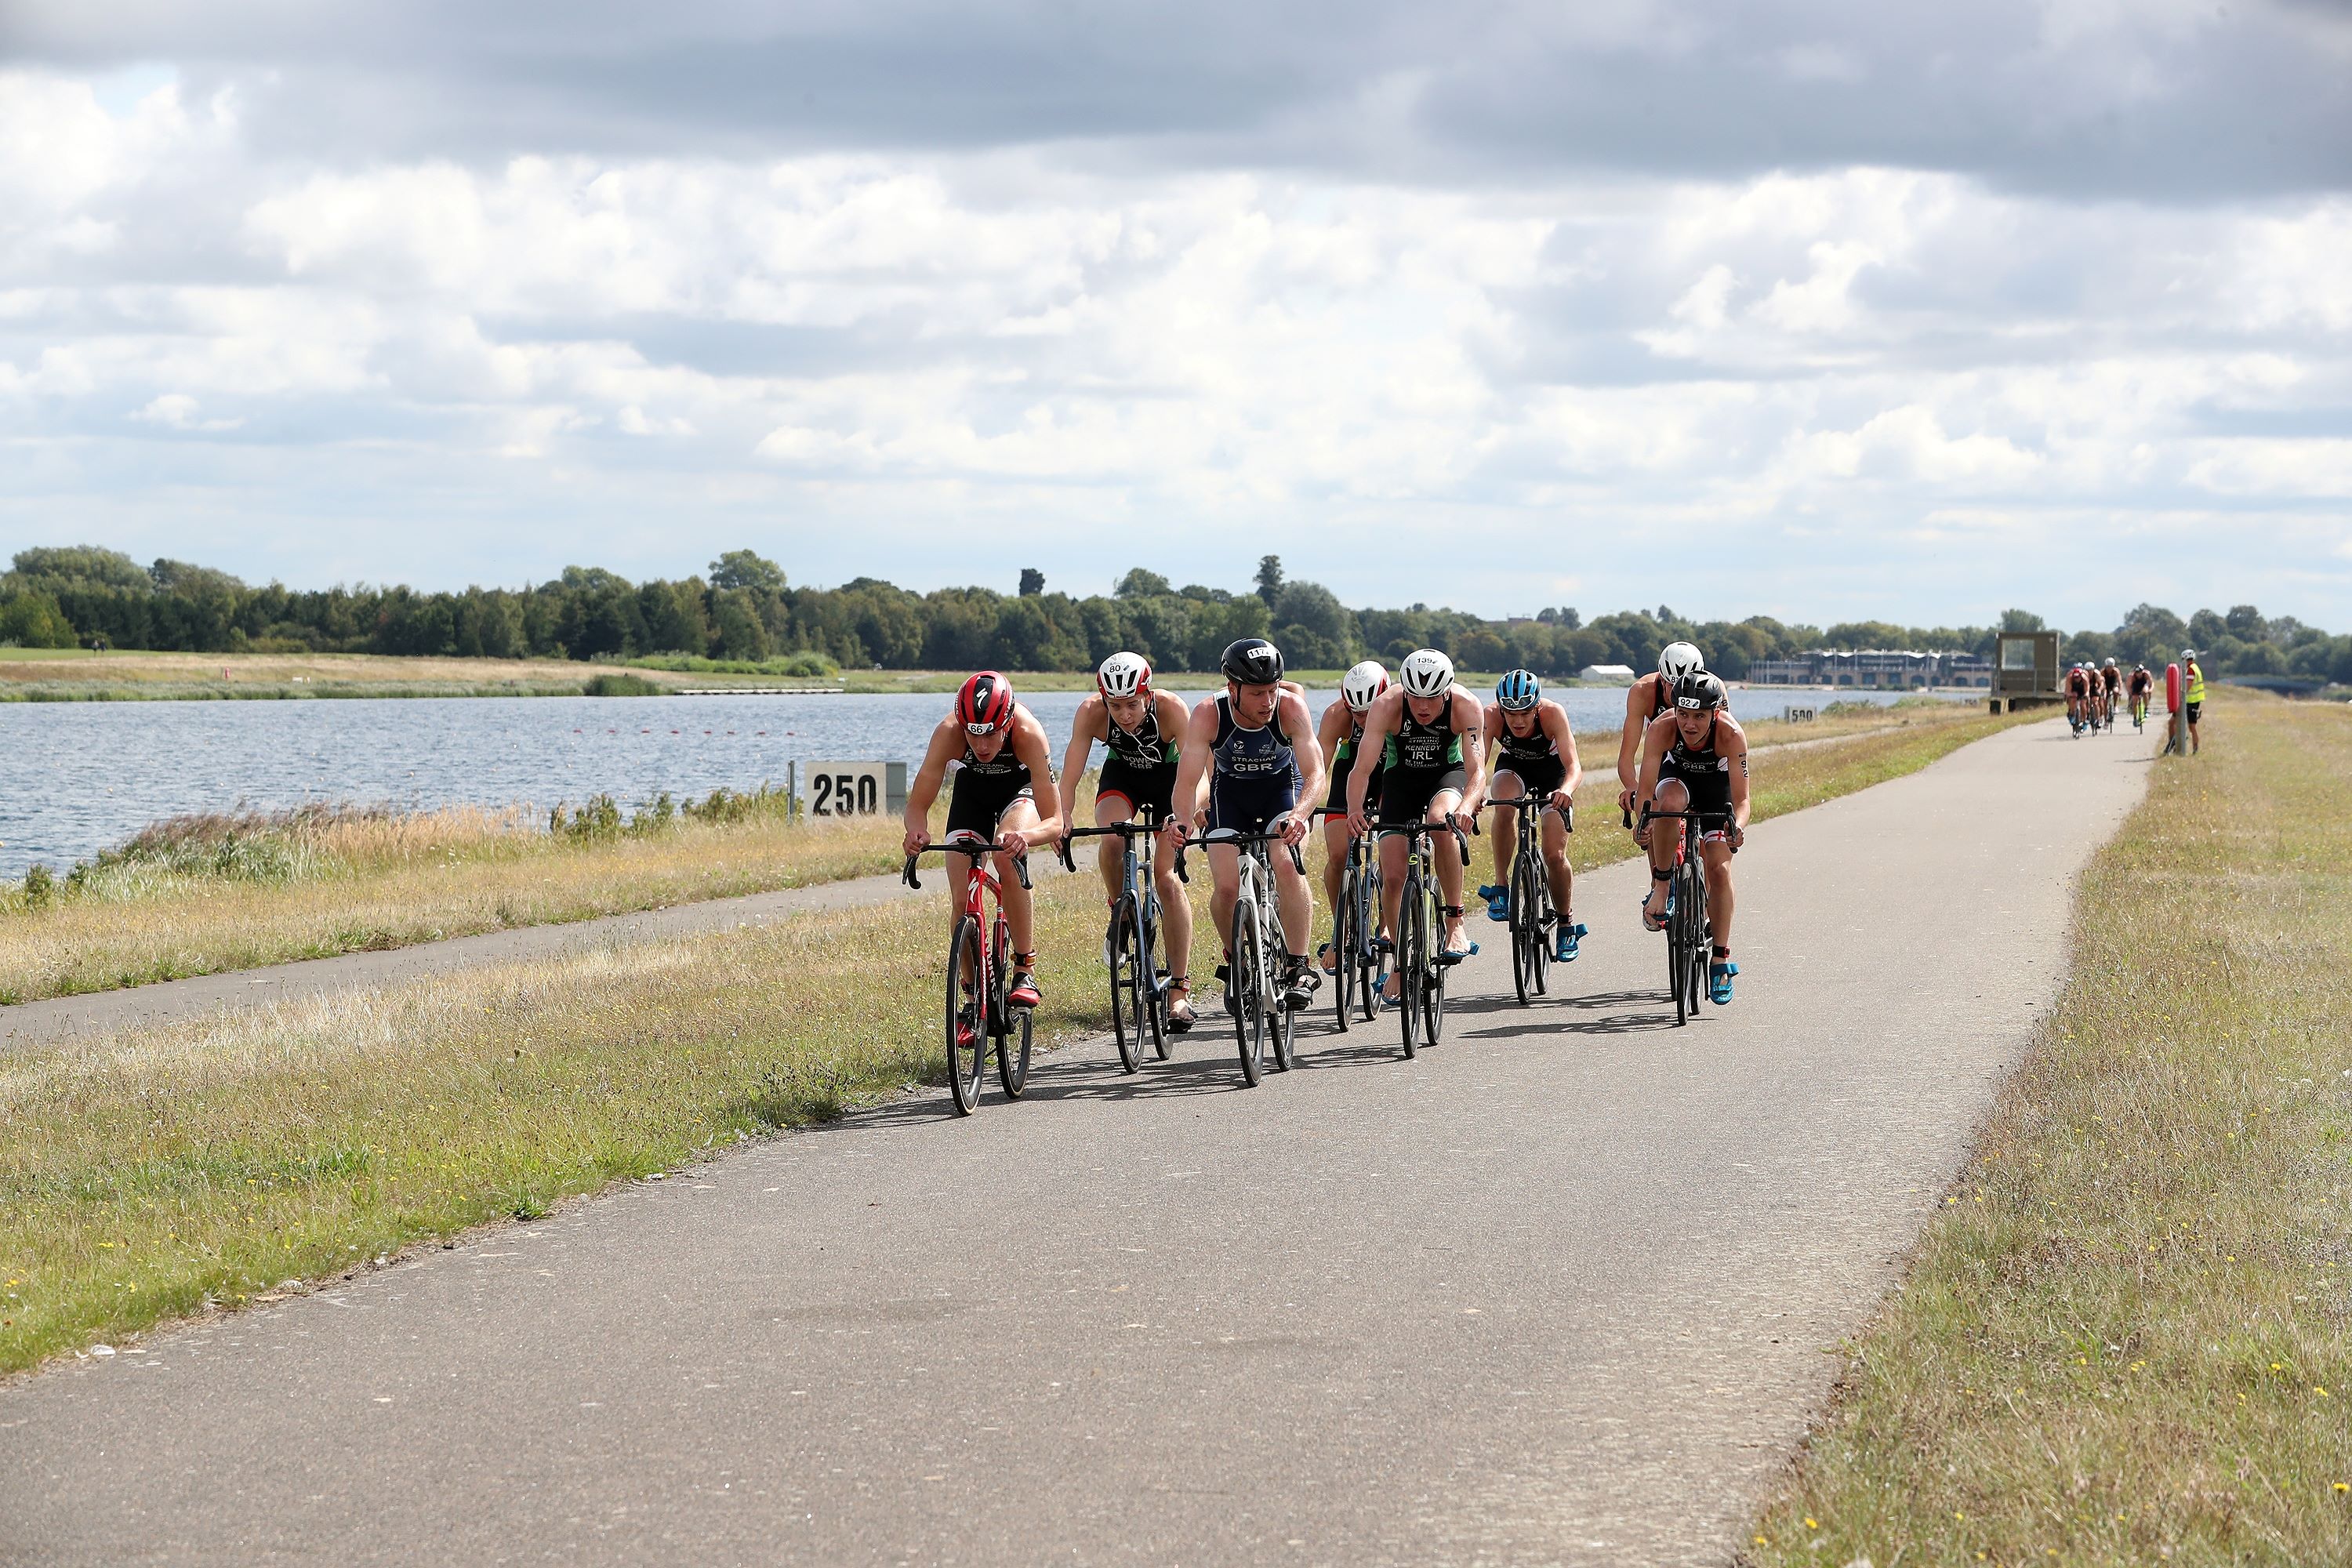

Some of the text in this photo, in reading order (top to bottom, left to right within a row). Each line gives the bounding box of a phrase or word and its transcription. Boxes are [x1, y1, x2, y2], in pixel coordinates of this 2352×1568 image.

[1249, 648, 1265, 657] 117
[1680, 698, 1690, 707] 92
[971, 724, 983, 734] 66
[1412, 751, 1433, 760] IRL
[1233, 763, 1273, 771] GBR
[1740, 760, 1748, 777] 92
[813, 774, 877, 816] 250
